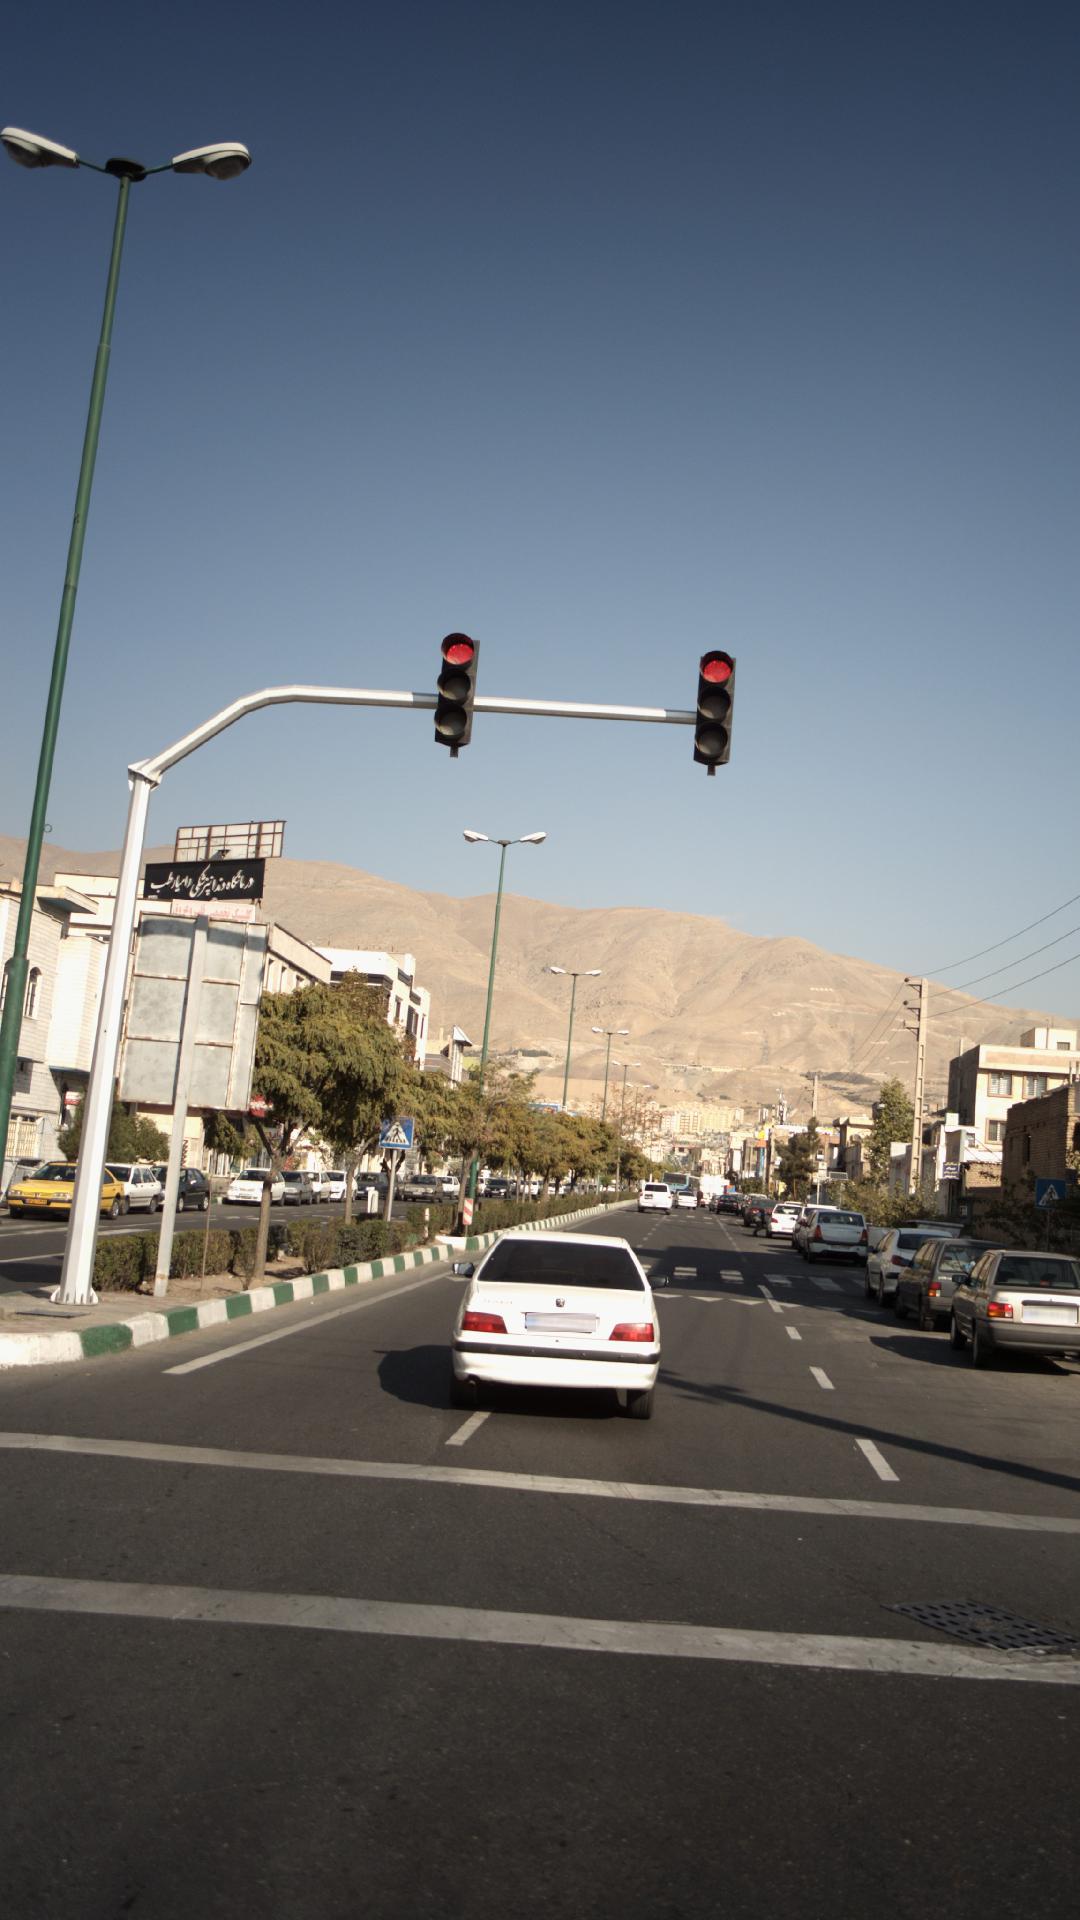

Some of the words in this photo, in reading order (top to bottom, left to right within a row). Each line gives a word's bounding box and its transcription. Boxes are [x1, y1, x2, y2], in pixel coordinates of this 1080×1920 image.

[150, 872, 173, 894] طب
[189, 863, 226, 898] دندانپزشکی
[225, 869, 254, 889] درمانگاه
